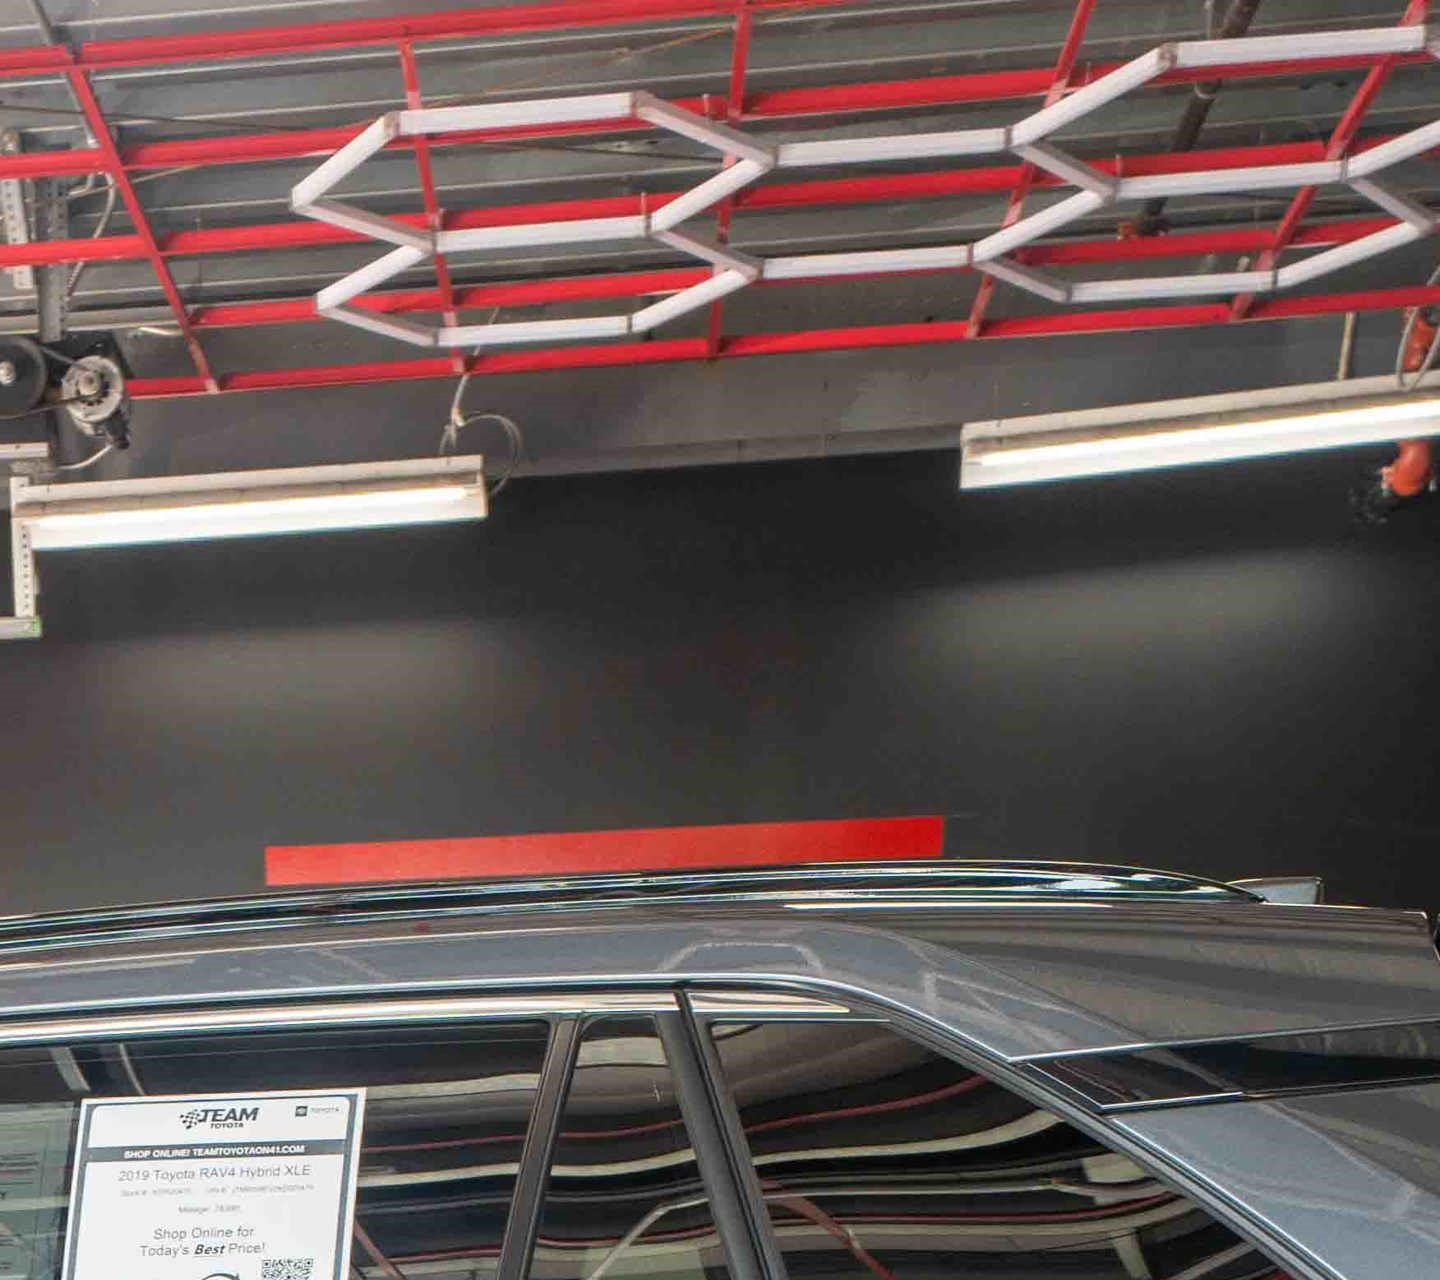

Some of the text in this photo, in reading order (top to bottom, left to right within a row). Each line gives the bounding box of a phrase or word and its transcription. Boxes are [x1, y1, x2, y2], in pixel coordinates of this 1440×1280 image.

[201, 1107, 259, 1123] TEAM
[124, 1150, 150, 1159] SHOP
[153, 1148, 190, 1158] ONLINE!
[118, 1164, 312, 1183] 2019 Toyota RAV4 Hybrid XLE
[153, 1225, 255, 1241] Shop Online for
[140, 1242, 266, 1259] Today's Best Price!
